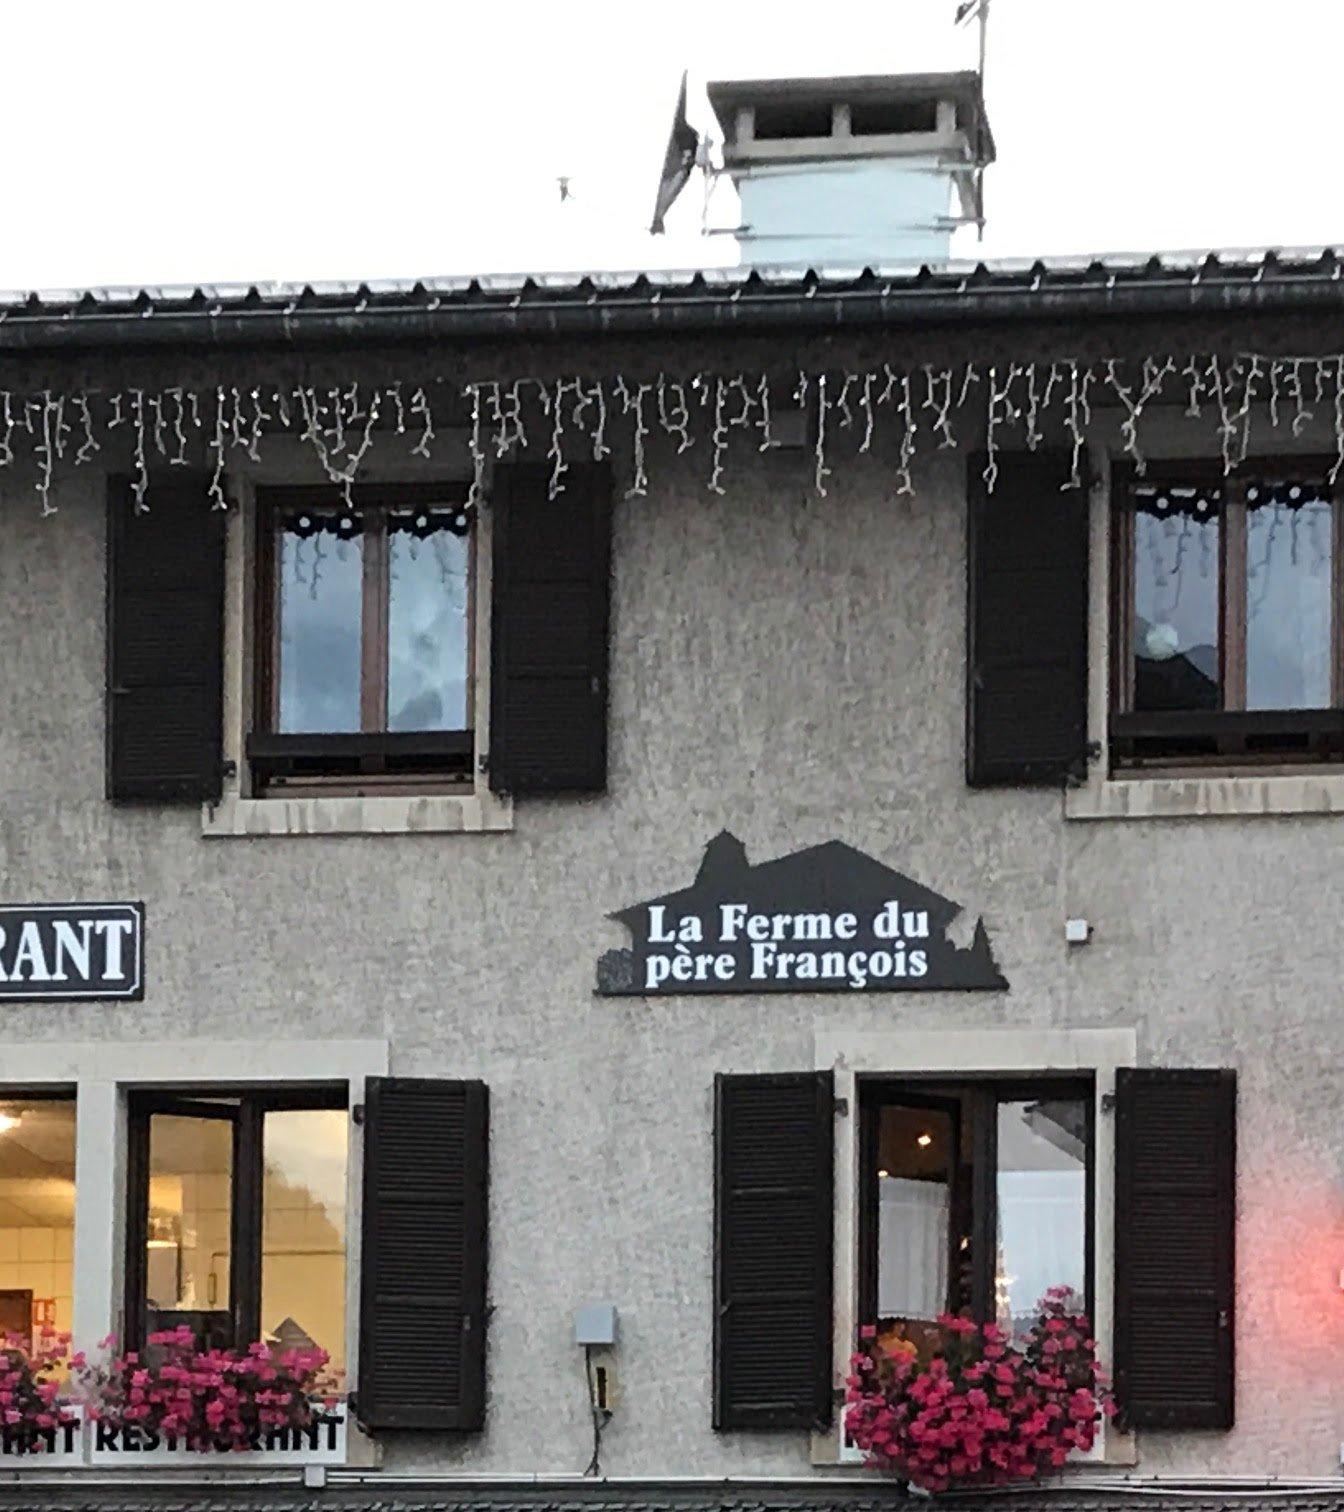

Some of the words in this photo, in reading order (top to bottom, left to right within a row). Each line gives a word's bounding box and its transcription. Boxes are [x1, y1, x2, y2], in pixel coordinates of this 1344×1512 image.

[647, 905, 703, 943] La
[719, 903, 856, 942] Ferme
[873, 901, 929, 940] du
[645, 944, 736, 988] père
[750, 941, 928, 987] François
[96, 1416, 344, 1451] RESRANT
